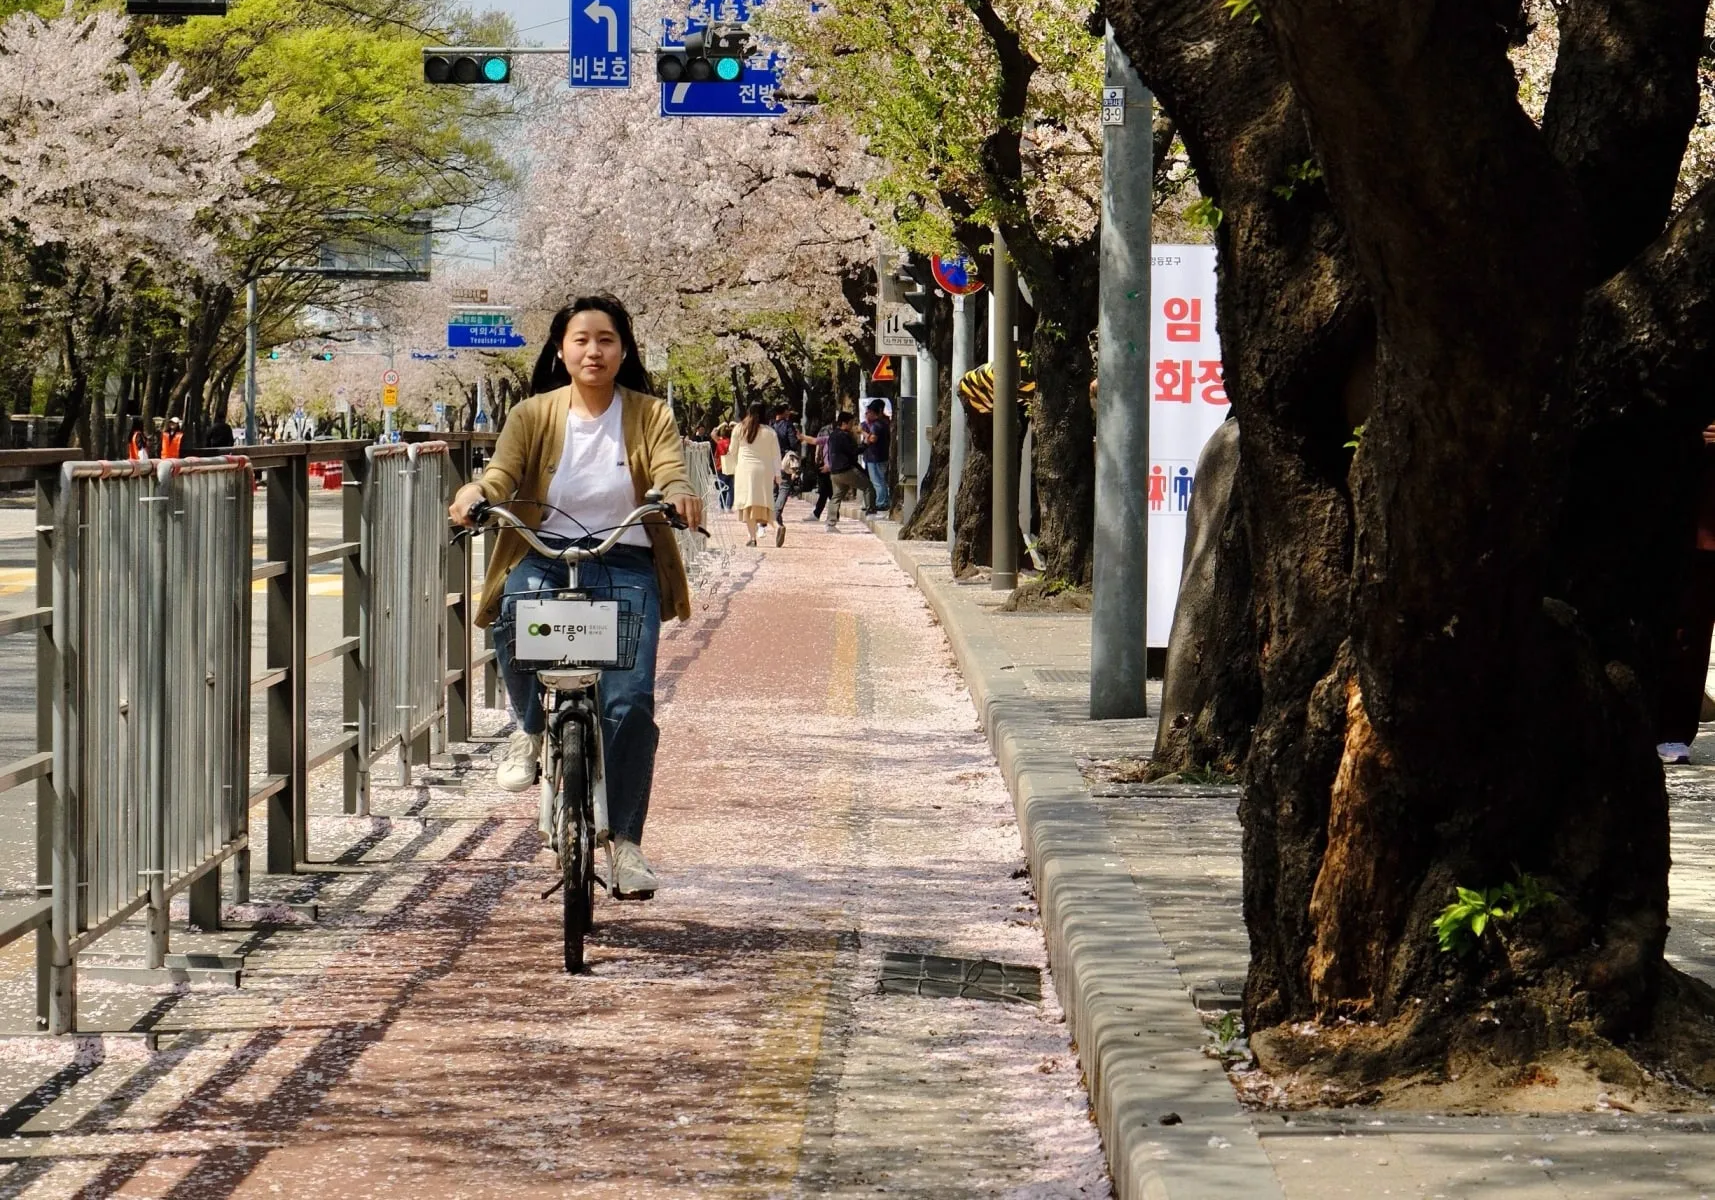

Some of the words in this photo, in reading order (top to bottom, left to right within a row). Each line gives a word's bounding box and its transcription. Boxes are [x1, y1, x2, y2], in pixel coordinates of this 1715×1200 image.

[572, 56, 628, 82] 비보호
[1103, 107, 1121, 122] 3-9
[1163, 297, 1201, 342] 임
[469, 327, 506, 336] 여의서로
[553, 624, 587, 642] 따릉이
